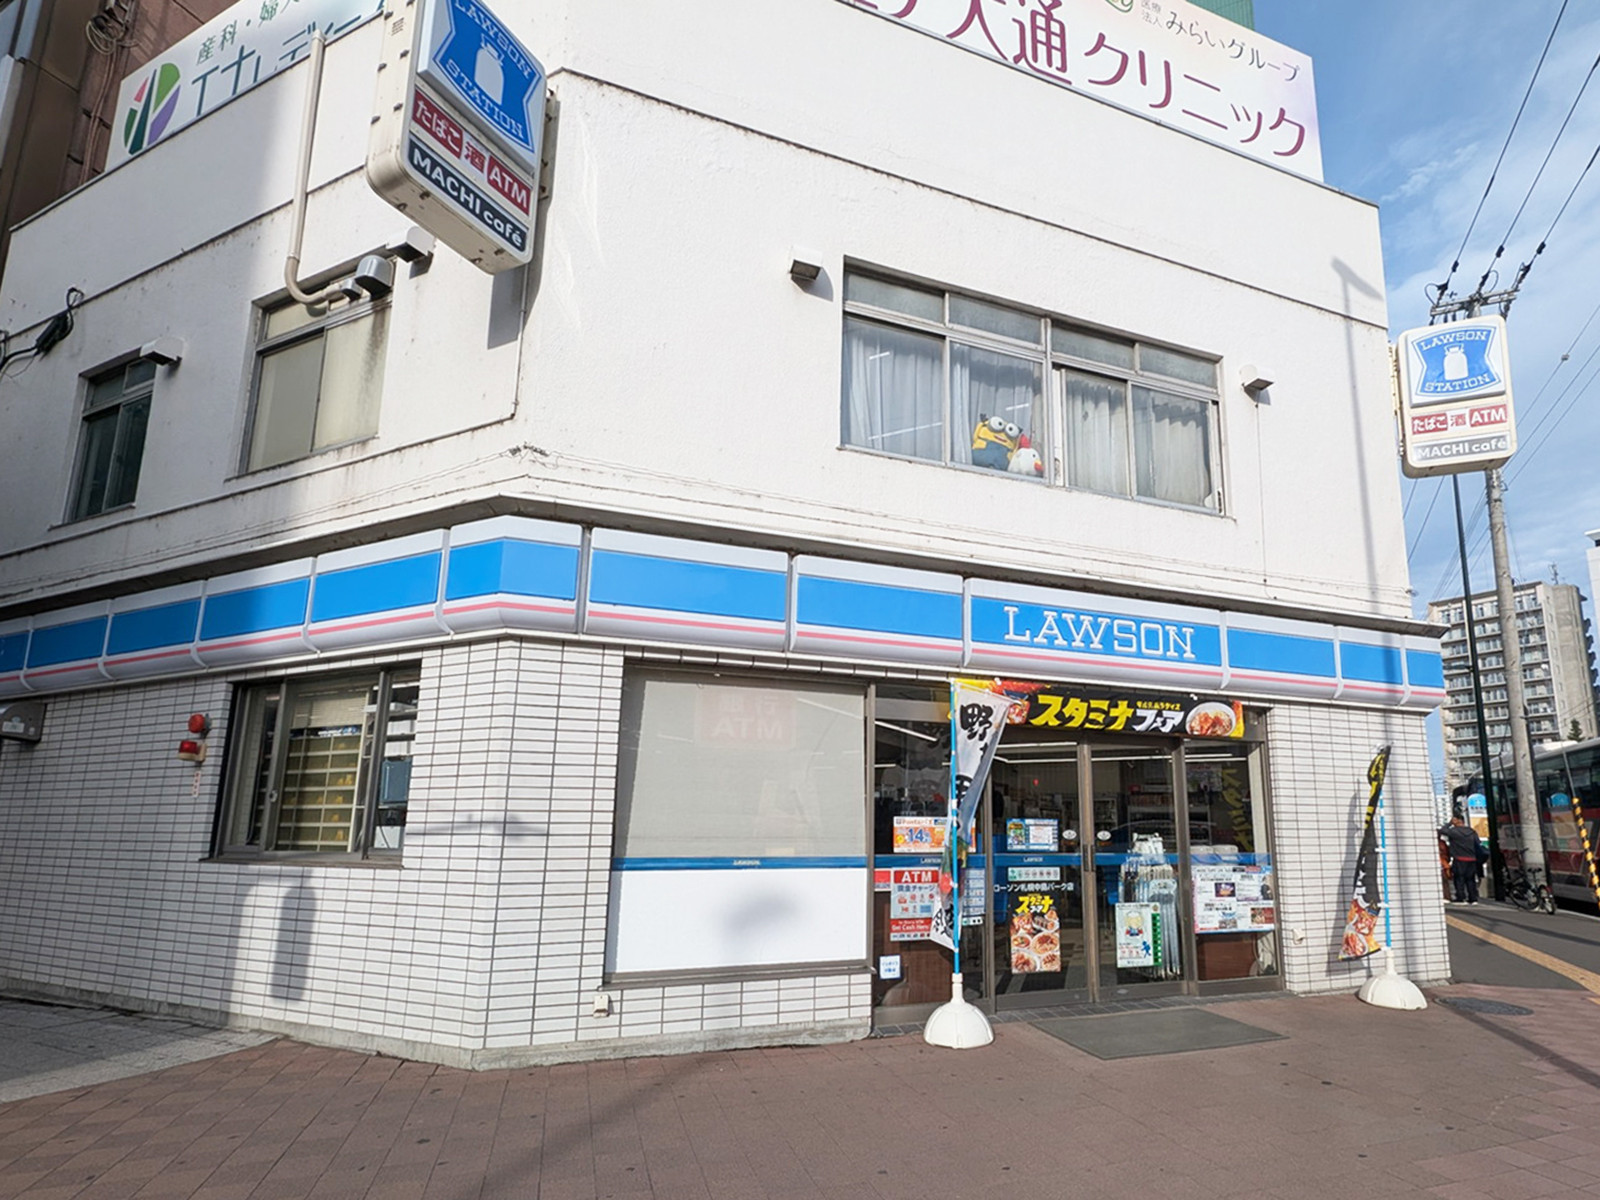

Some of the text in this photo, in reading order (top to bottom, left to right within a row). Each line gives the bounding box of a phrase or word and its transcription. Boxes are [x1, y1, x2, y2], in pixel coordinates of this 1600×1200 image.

[454, 0, 531, 79] LAWSON
[1166, 11, 1300, 82] みらいグループ
[445, 59, 524, 140] STATION
[416, 100, 528, 209] たばこ 酒 ATM
[413, 148, 523, 247] MACHI café
[1420, 330, 1488, 352] LAWSON
[1424, 373, 1491, 392] STATION
[1412, 414, 1447, 432] たばこ
[1471, 406, 1507, 424] ATM
[1417, 438, 1507, 459] MACHI café
[1004, 606, 1196, 659] LAWSON
[711, 716, 785, 740] ATM
[1030, 694, 1135, 731] スタミナ
[1132, 709, 1185, 733] フェア
[902, 871, 932, 883] ATM
